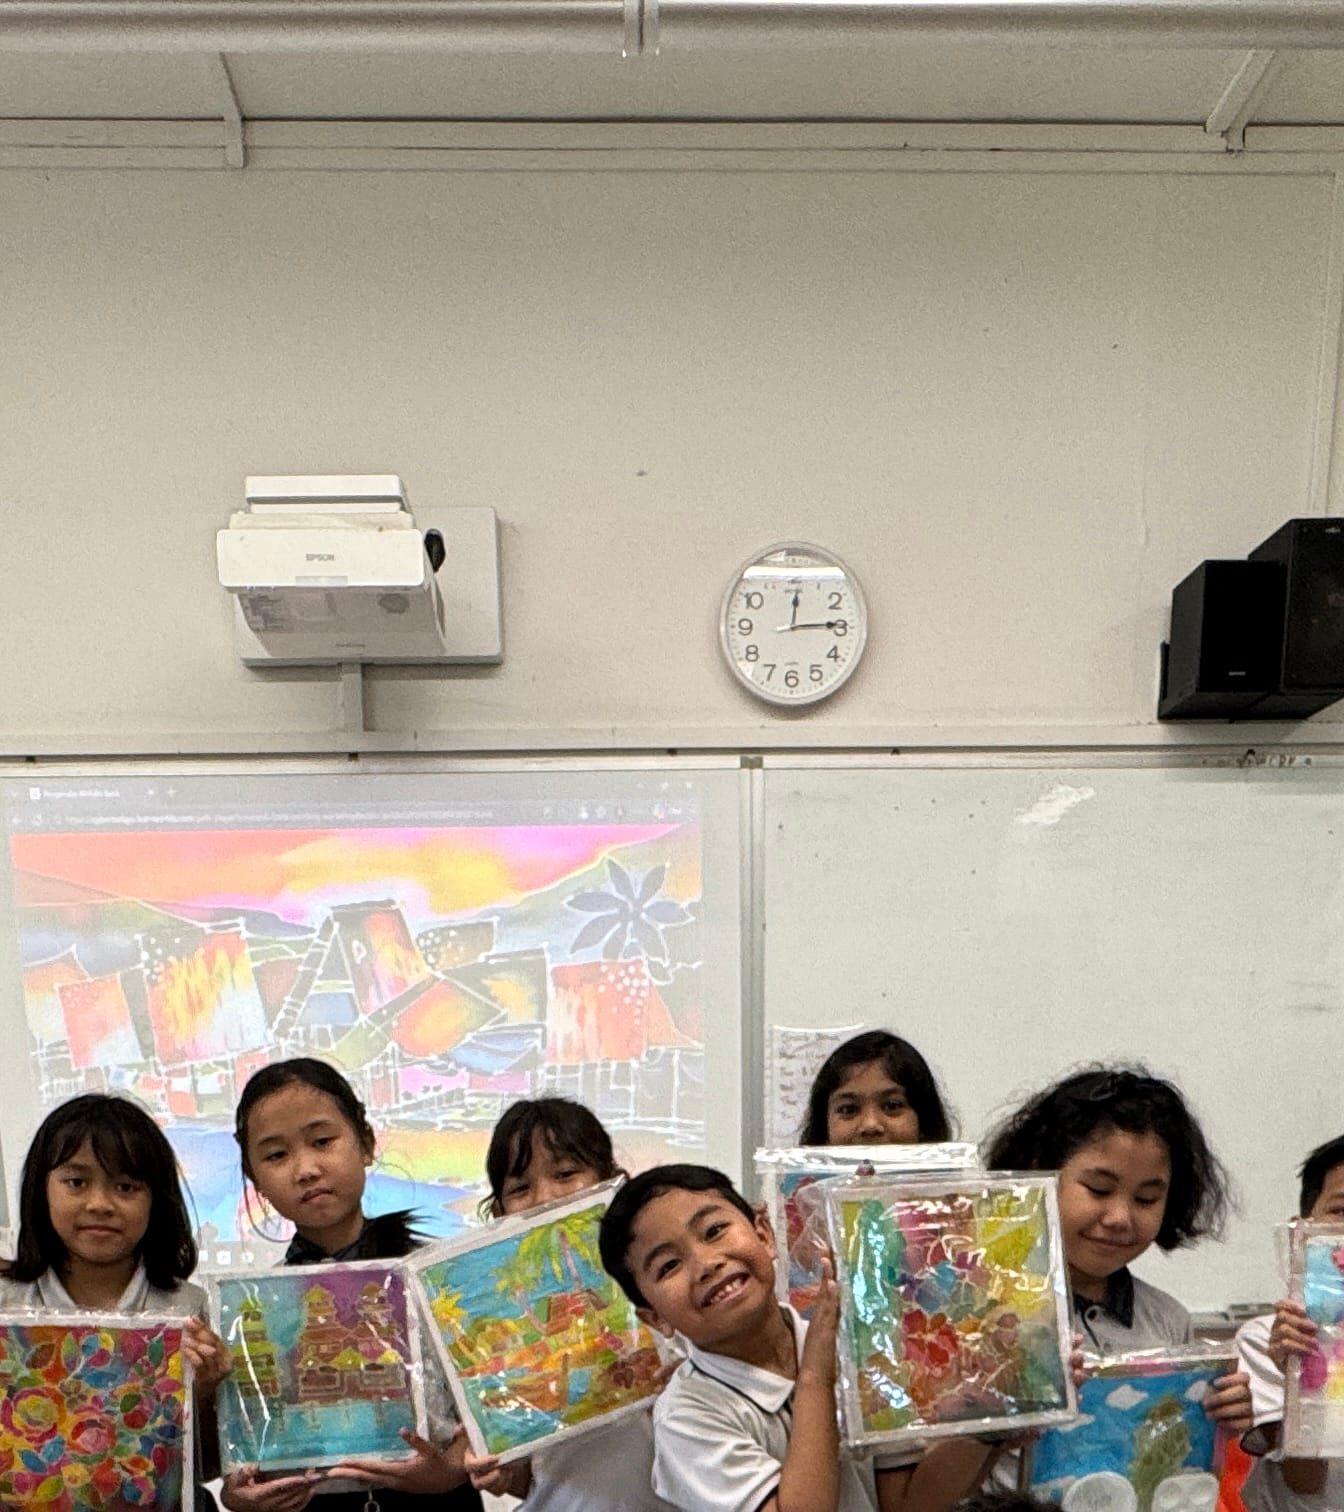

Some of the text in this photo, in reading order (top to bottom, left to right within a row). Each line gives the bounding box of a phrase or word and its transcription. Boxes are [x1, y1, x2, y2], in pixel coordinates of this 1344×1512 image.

[306, 553, 335, 561] EPSON
[744, 591, 764, 609] 10
[828, 592, 843, 610] 2
[738, 618, 753, 636] 9
[833, 619, 848, 637] 3
[745, 645, 760, 662] 8
[826, 645, 840, 662] 4
[763, 664, 776, 682] 7
[784, 670, 799, 688] 6
[809, 664, 823, 682] 5
